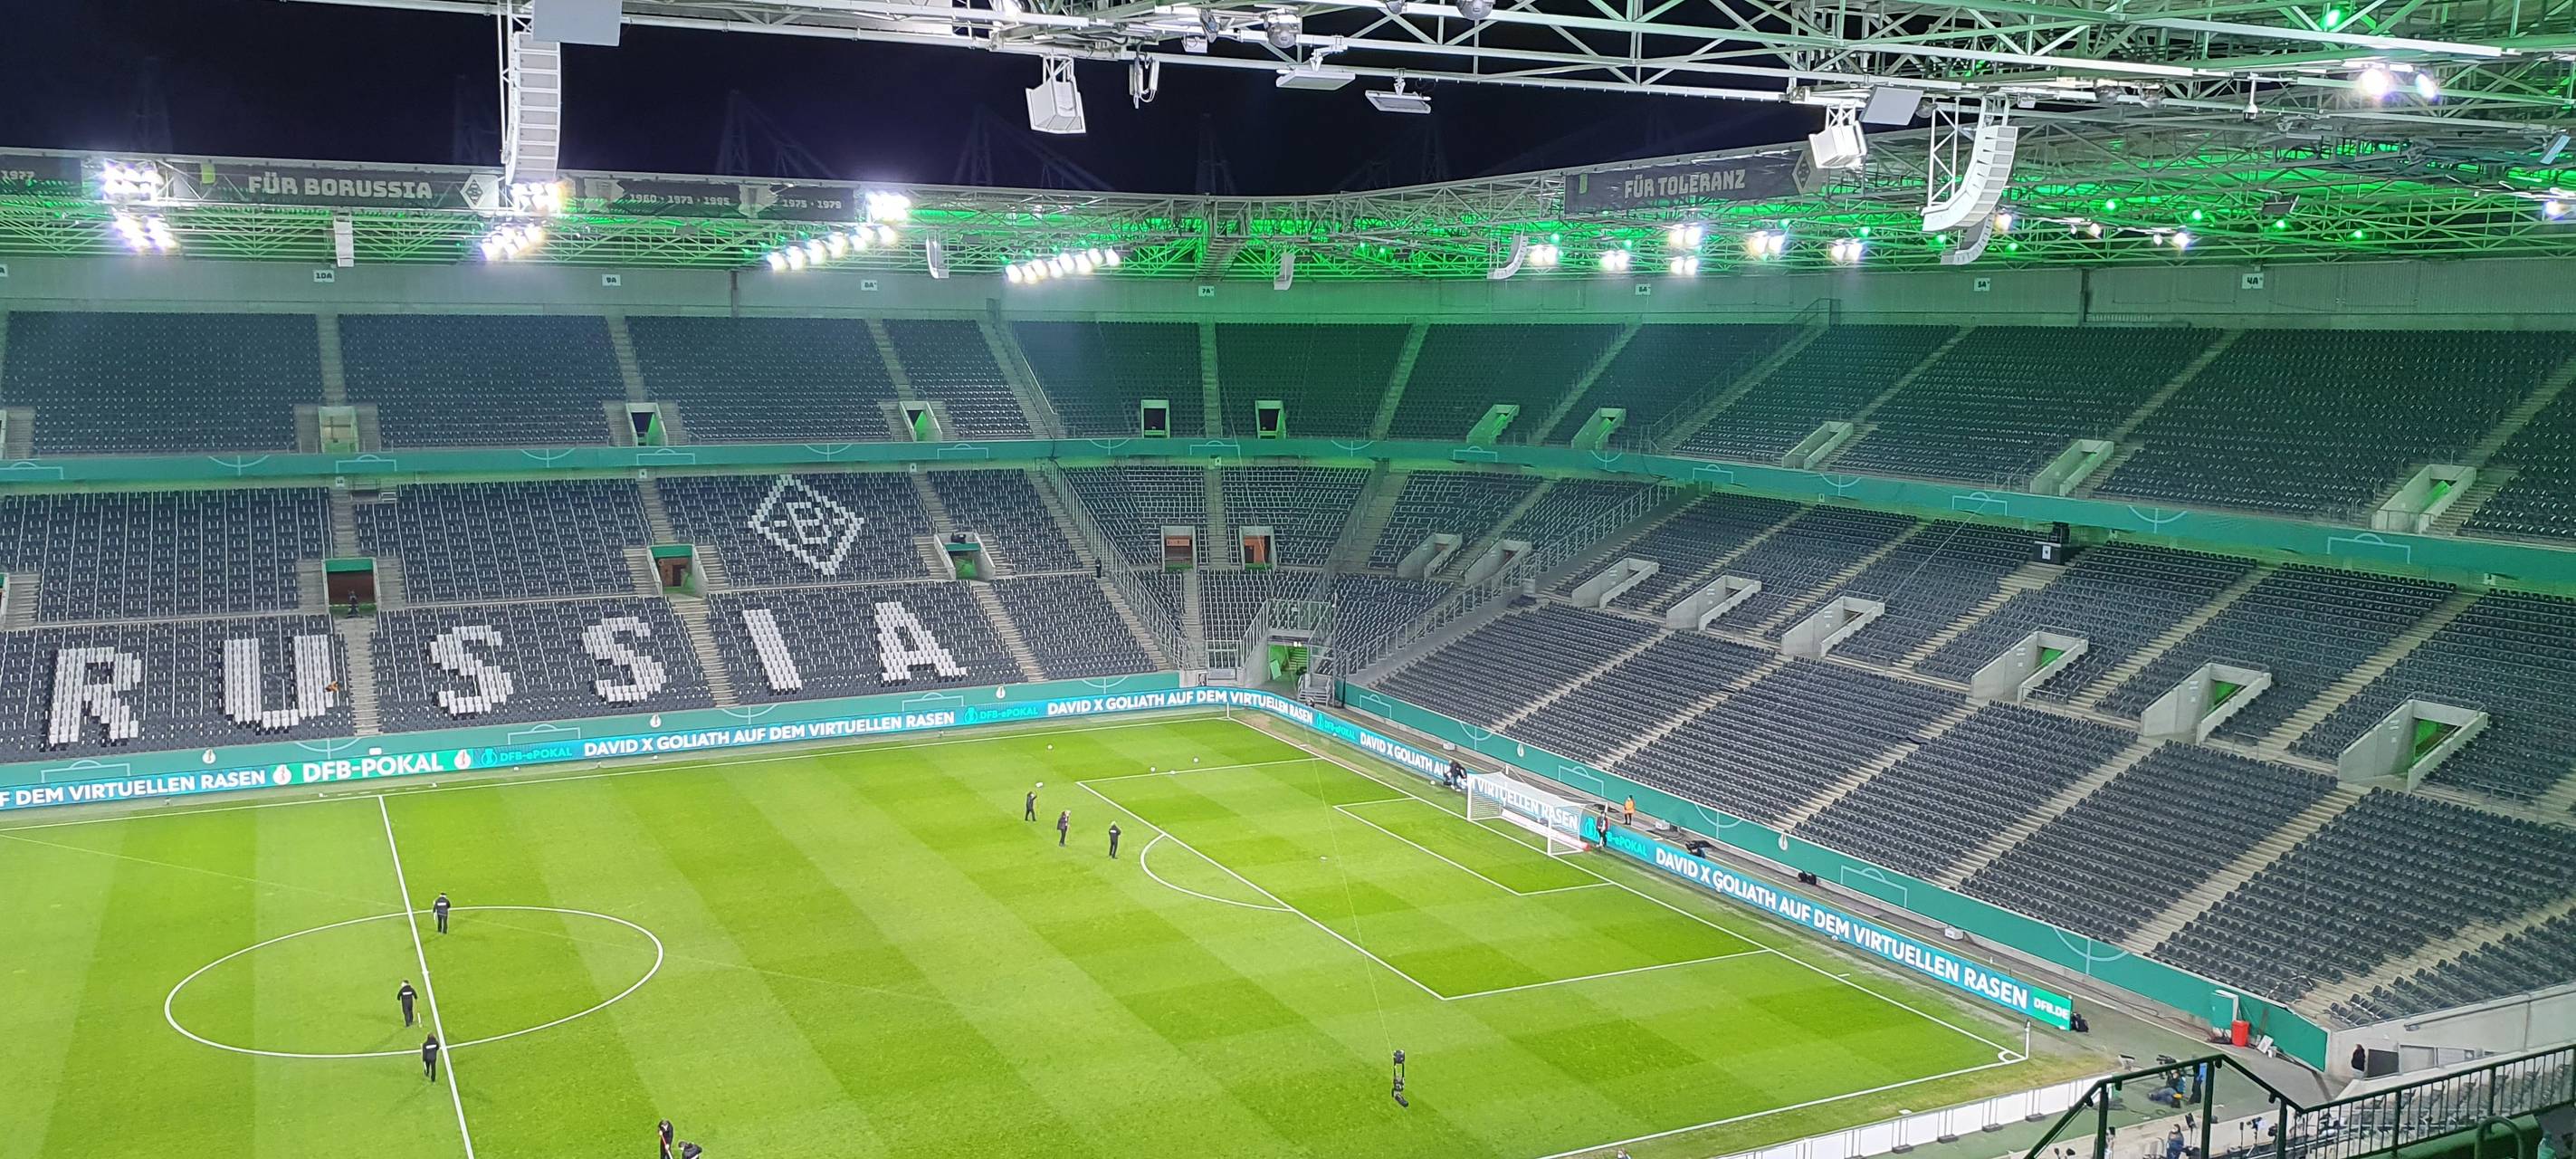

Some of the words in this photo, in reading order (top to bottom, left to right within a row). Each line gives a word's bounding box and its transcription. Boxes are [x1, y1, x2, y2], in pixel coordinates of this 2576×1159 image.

[247, 171, 298, 195] FÜR
[304, 178, 433, 199] BORUSSIA
[1624, 173, 1655, 198] FÜR
[1657, 169, 1746, 196] TOLERANZ
[782, 199, 807, 208] 1975
[816, 200, 842, 209] 1979
[979, 706, 1039, 720] DFB-ePOKAL
[1047, 698, 1091, 715] DAVID
[1093, 698, 1103, 712] X
[1105, 693, 1166, 710] GOLIATH
[1168, 691, 1194, 704] AUF
[1196, 690, 1227, 703] DEM
[1229, 691, 1289, 714] VIRTUELLEN
[1289, 703, 1313, 723] RASEN
[584, 738, 639, 758] DAVID
[642, 739, 654, 752] X
[656, 731, 727, 751] GOLIATH
[733, 727, 767, 743] AUF
[769, 723, 806, 742] DEM
[808, 715, 902, 738] VIRTUELLEN
[906, 711, 955, 728] RASEN
[499, 746, 573, 763] DFB-ePOKAL
[1360, 731, 1387, 753] DAVID
[1387, 742, 1394, 756] X
[1394, 745, 1434, 772] GOLIATH
[302, 752, 444, 783] DFB-POKAL
[15, 786, 71, 806] DEM
[68, 774, 196, 800] VIRTUELLEN
[200, 770, 266, 790] RASEN
[1475, 778, 1539, 814] VIRTUELLEN
[1541, 803, 1579, 832] RASEN
[1606, 830, 1647, 857] B-ePOKAL
[1655, 847, 1698, 877] DAVID
[1700, 867, 1711, 885] X
[1713, 870, 1777, 910] GOLIATH
[1778, 896, 1811, 922] AUF
[1813, 905, 1851, 938] DEM
[1853, 924, 1960, 982] VIRTUELLEN
[1963, 967, 2027, 1010] RASEN
[2033, 996, 2071, 1020] DFB.DE
